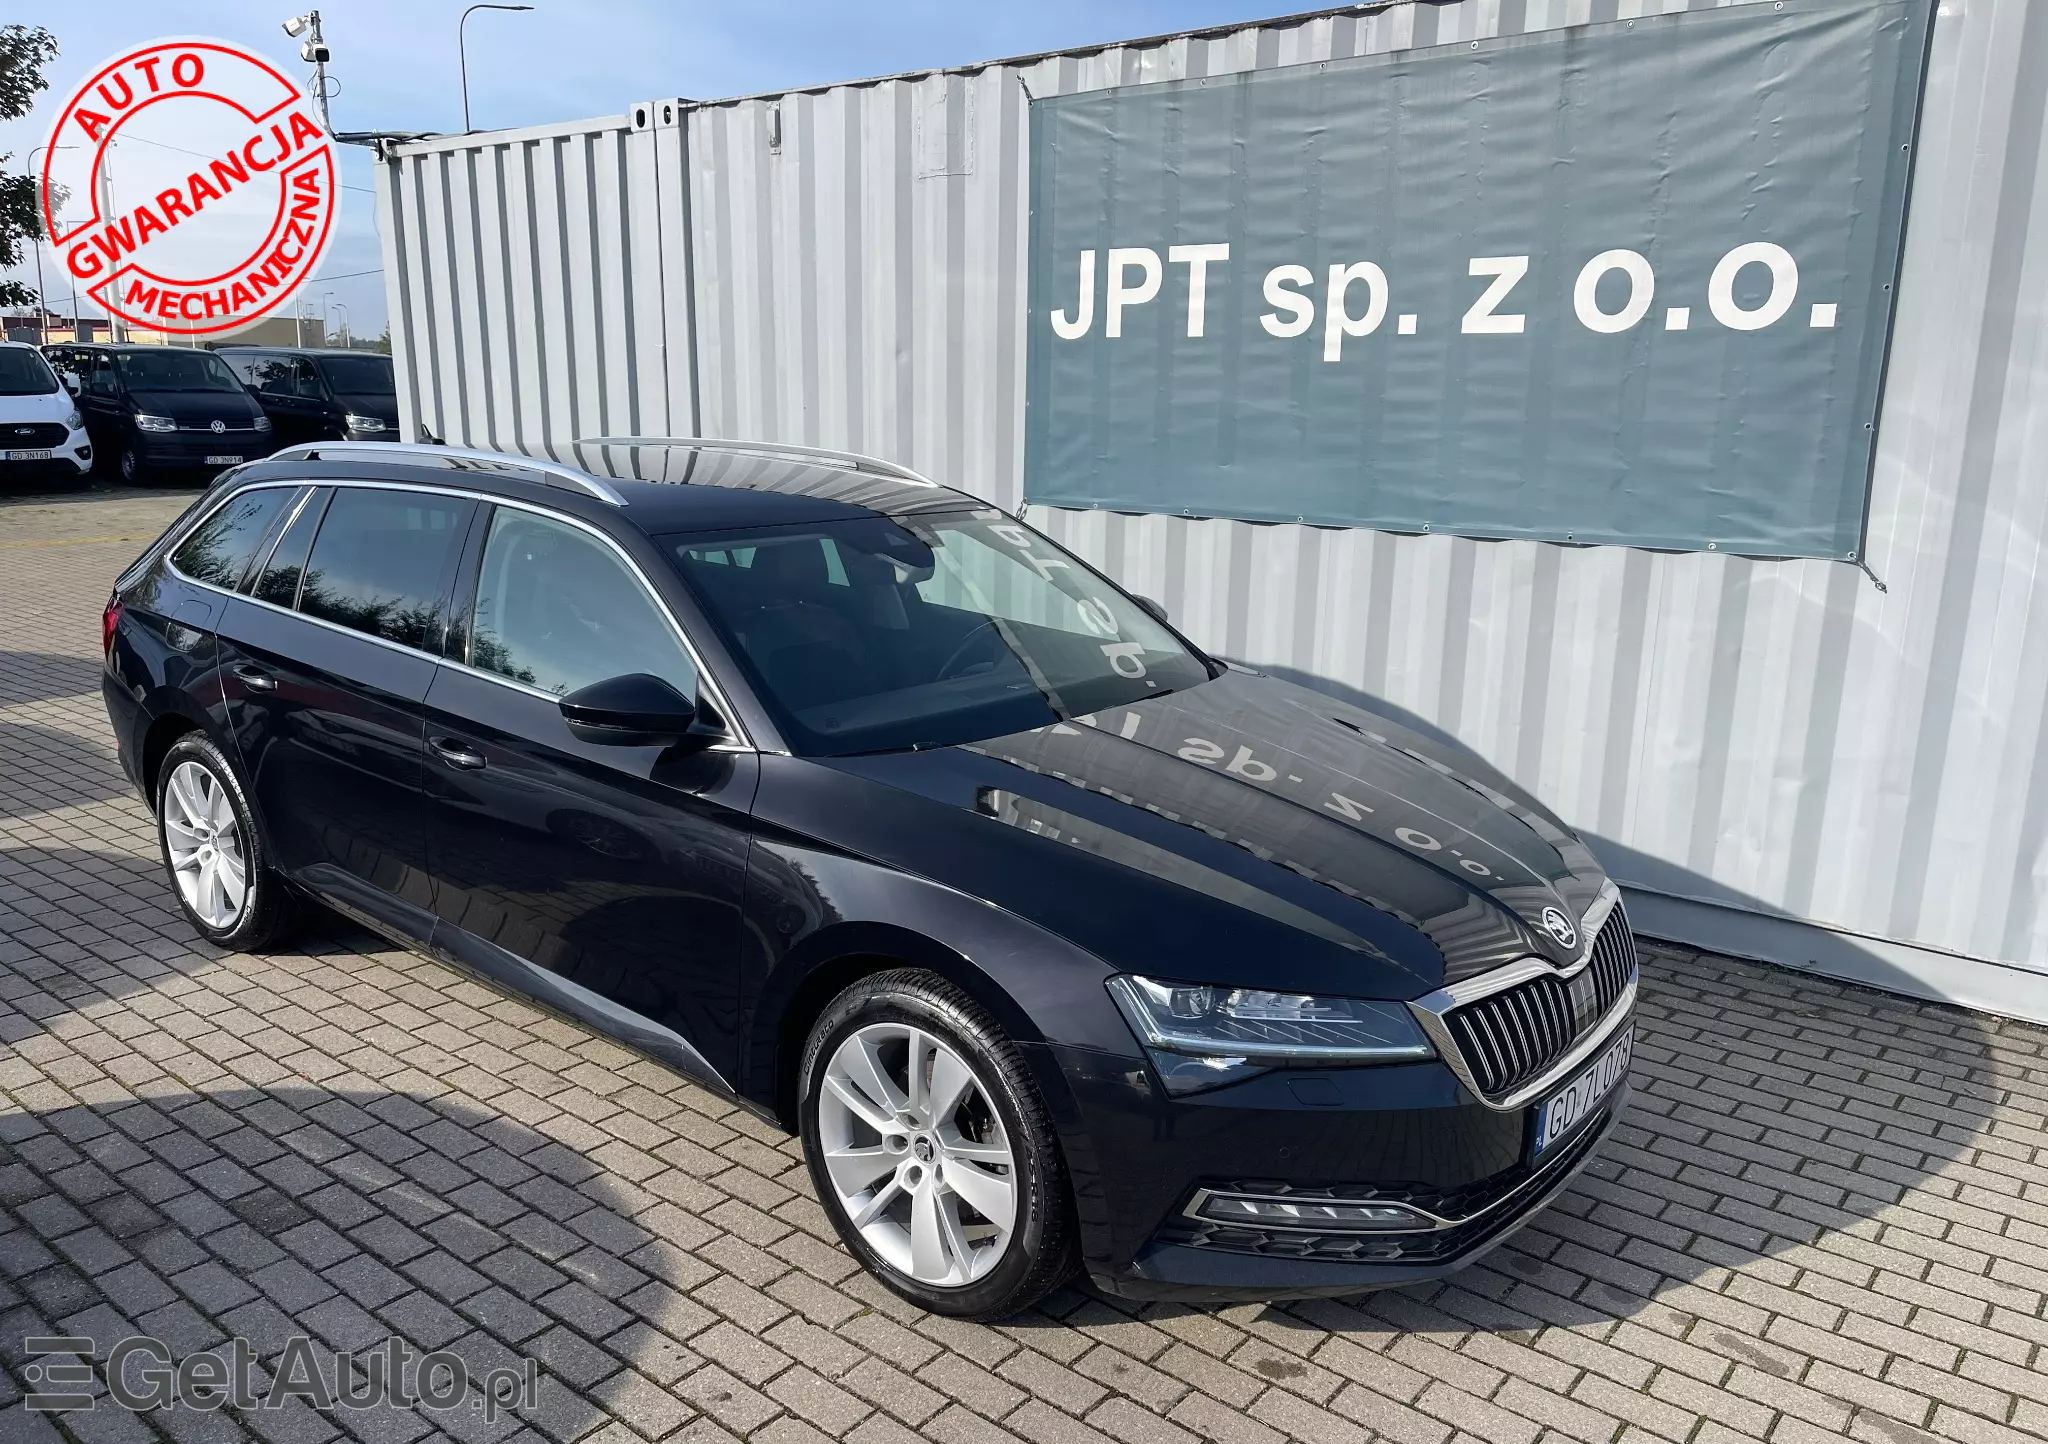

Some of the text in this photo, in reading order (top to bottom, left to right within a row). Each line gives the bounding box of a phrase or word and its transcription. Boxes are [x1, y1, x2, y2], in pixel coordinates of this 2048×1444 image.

[1051, 241, 1838, 362] JPT sp. z o.o.
[11, 452, 23, 460] GD
[208, 456, 219, 464] GD
[1535, 1033, 1630, 1147] PL GD 7L078
